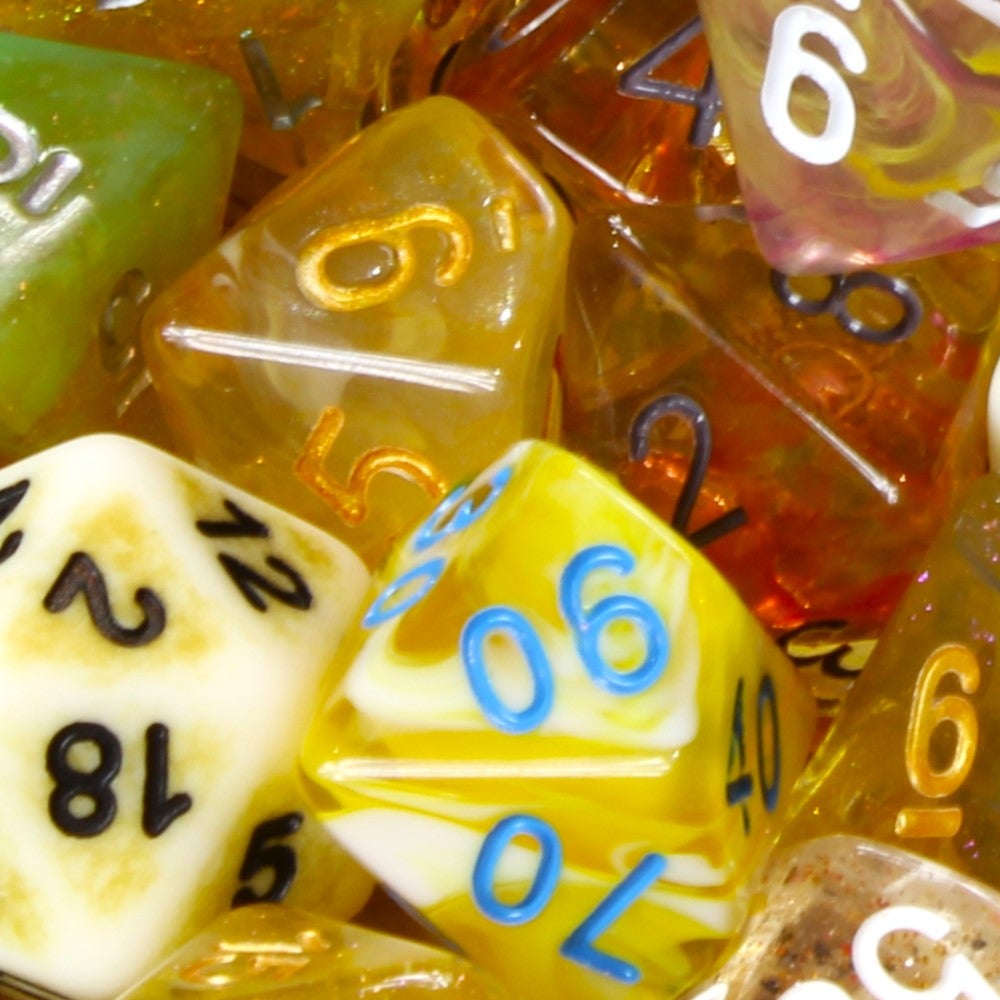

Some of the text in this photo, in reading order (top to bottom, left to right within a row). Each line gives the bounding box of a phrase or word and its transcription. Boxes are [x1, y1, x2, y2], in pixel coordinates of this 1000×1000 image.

[294, 405, 450, 528] 5
[42, 550, 167, 647] 2
[905, 641, 981, 798] 6
[45, 721, 193, 840] 18
